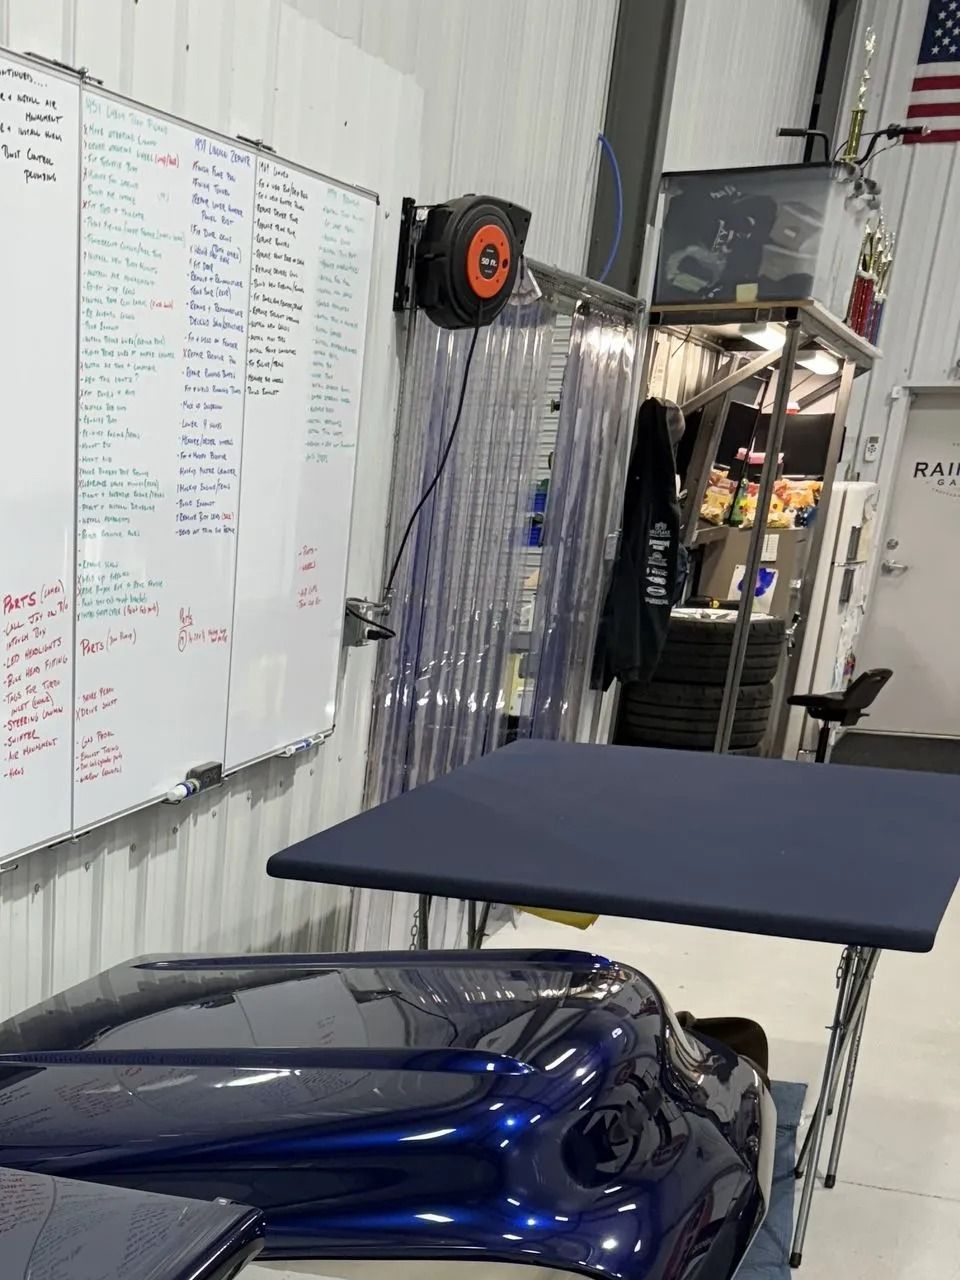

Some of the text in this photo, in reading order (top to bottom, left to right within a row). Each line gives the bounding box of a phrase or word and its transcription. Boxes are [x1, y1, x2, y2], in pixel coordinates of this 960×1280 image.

[481, 258, 490, 266] 50
[3, 591, 36, 615] PARTS
[80, 638, 105, 656] PARTS
